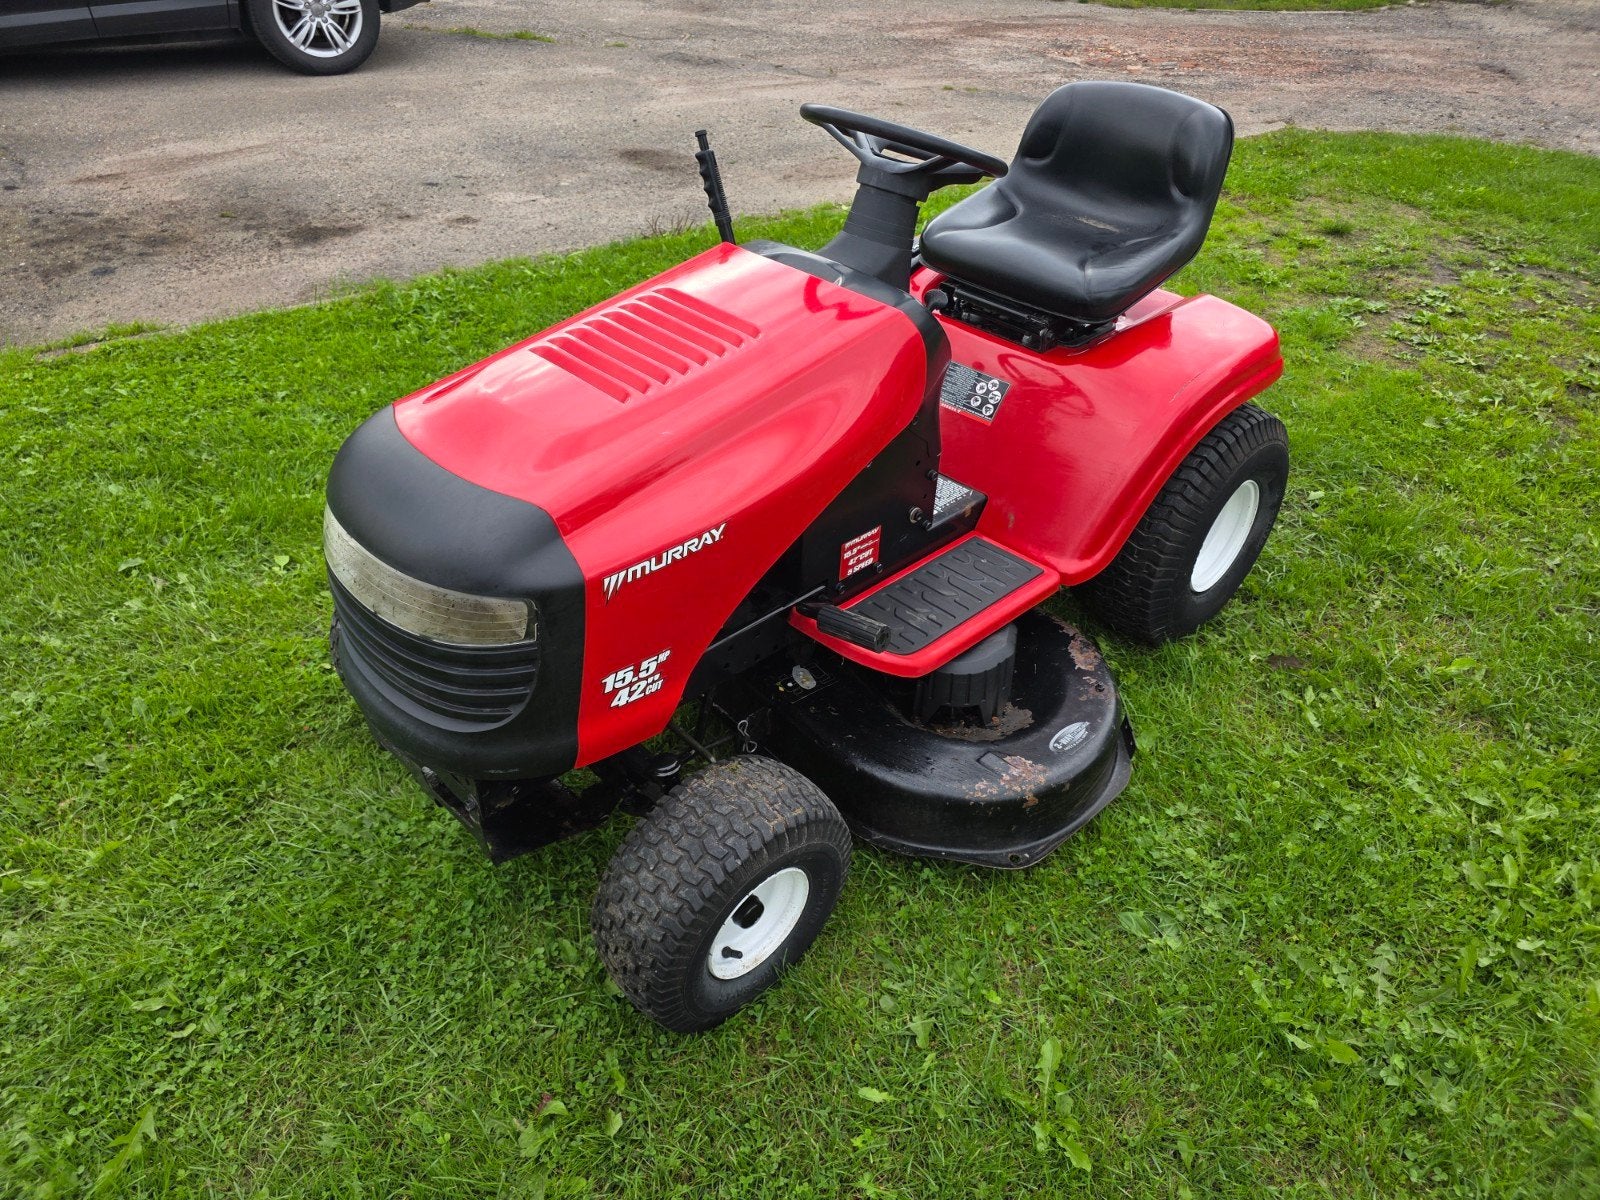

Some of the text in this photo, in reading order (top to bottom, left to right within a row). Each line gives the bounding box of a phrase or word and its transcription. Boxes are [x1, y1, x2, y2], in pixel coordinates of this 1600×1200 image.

[627, 522, 727, 583] MURRAY
[601, 656, 658, 694] 15.5
[645, 679, 664, 695] CUT
